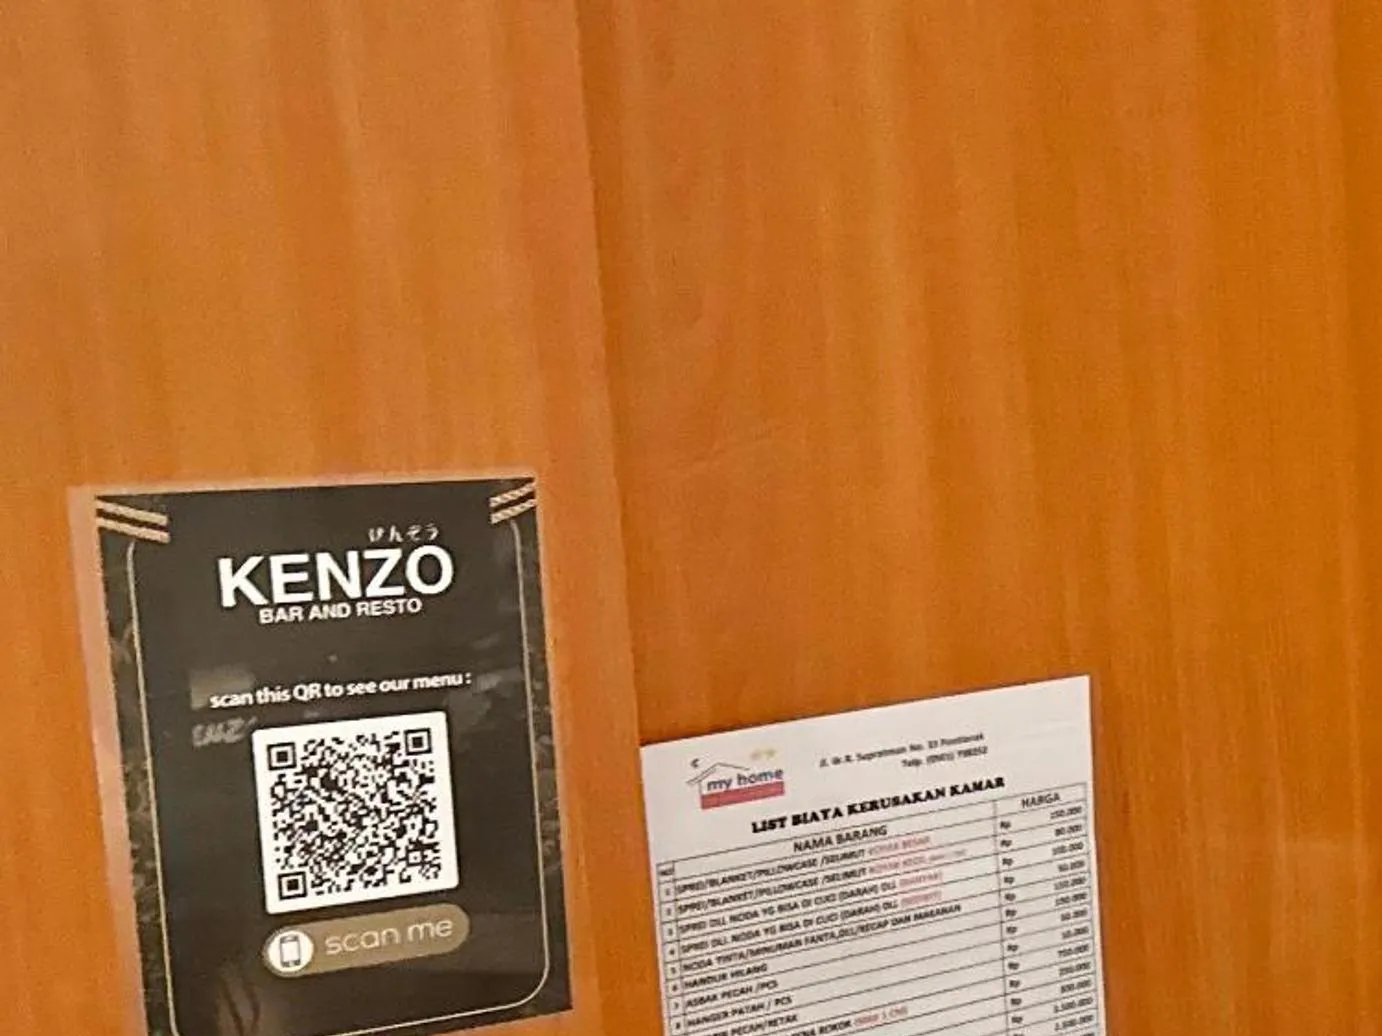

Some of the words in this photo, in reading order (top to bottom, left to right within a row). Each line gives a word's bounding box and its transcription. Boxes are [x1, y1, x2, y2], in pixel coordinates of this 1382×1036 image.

[217, 545, 454, 608] KENZO
[259, 606, 303, 624] BAR
[309, 602, 351, 621] AND
[356, 598, 423, 617] RESTO
[210, 690, 254, 708] scan
[256, 686, 291, 704] this
[293, 683, 322, 702] QR
[324, 681, 343, 698] to
[346, 682, 377, 696] see
[379, 679, 410, 693] our
[412, 673, 463, 690] menu
[706, 776, 732, 793] my
[736, 766, 783, 786] home
[751, 816, 787, 833] LIST
[847, 787, 945, 815] KERUSAKAN
[949, 776, 1004, 796] KAMAR
[1021, 791, 1060, 808] HARGA
[793, 835, 832, 852] NAMA
[835, 824, 887, 844] BARANG
[324, 926, 401, 955] scan
[406, 918, 454, 943] me
